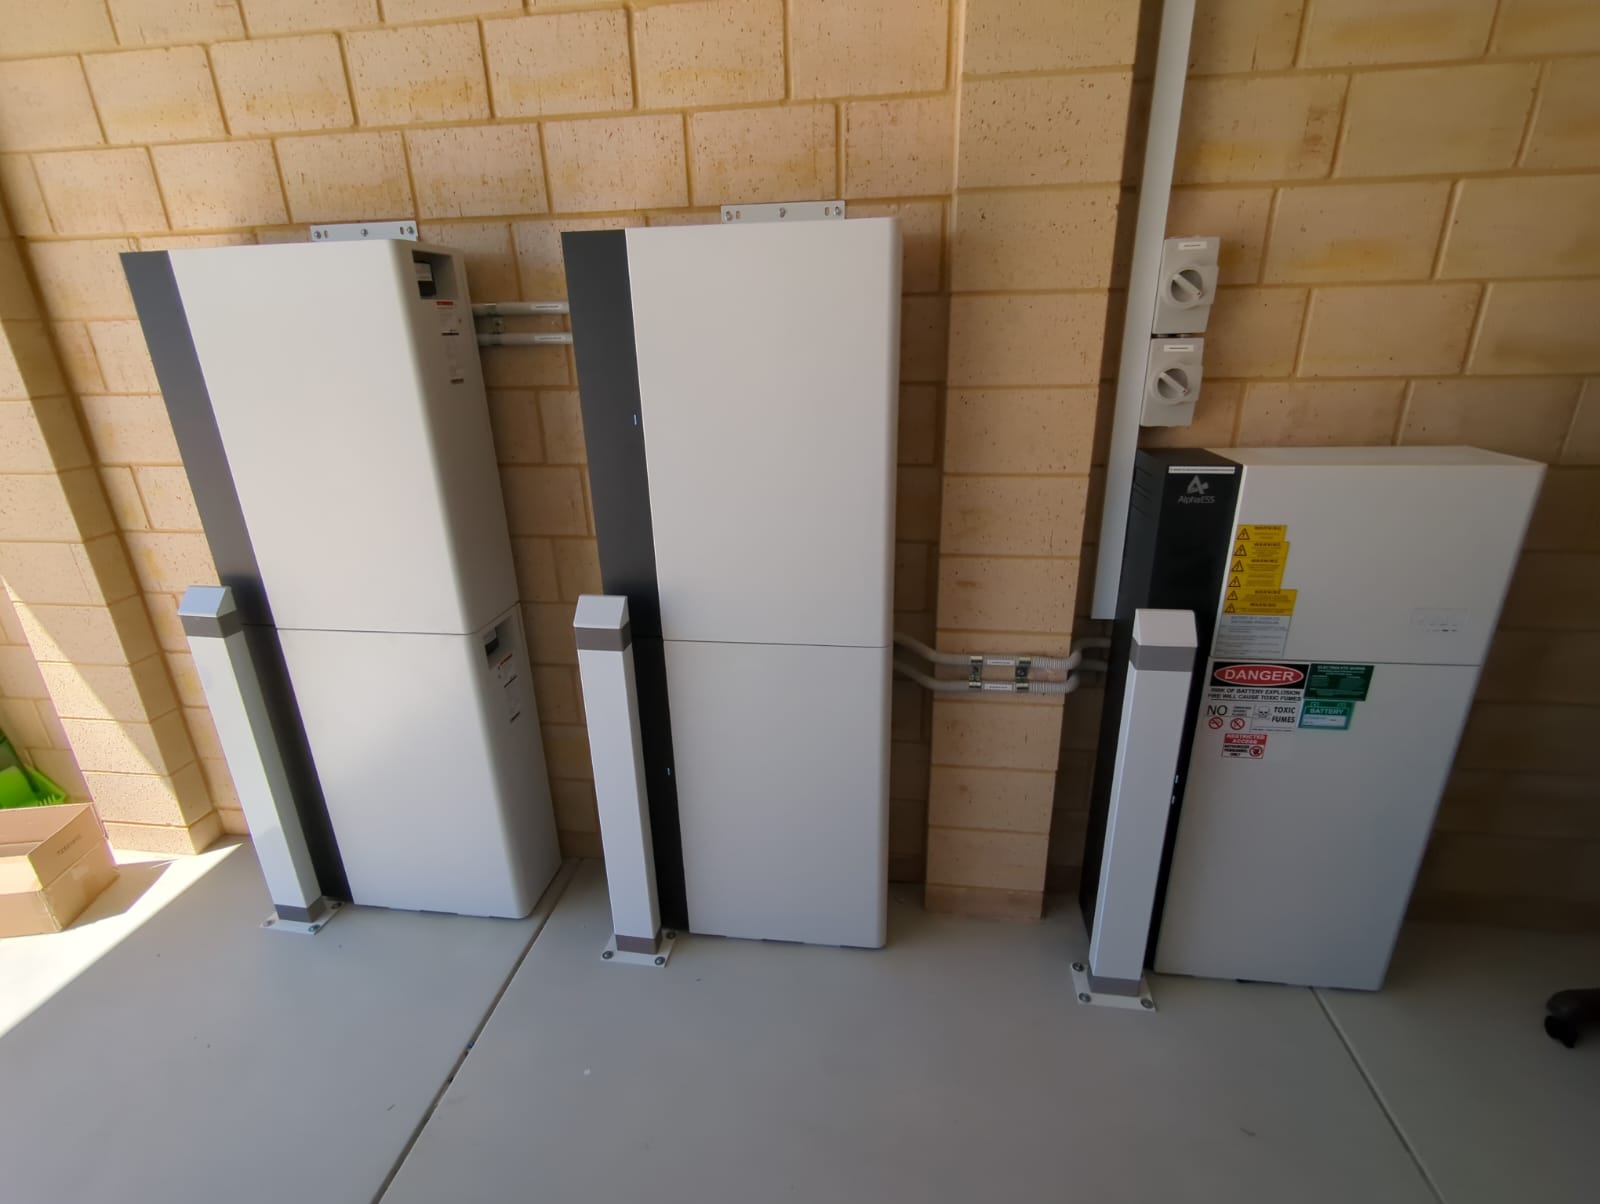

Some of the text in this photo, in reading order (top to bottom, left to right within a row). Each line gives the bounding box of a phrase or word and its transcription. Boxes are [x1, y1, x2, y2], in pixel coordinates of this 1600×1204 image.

[1178, 496, 1216, 504] AlphaESS
[1224, 669, 1294, 682] DANGER
[1207, 704, 1228, 716] NO
[1274, 706, 1296, 714] TOXIC
[1271, 716, 1296, 724] FUMES
